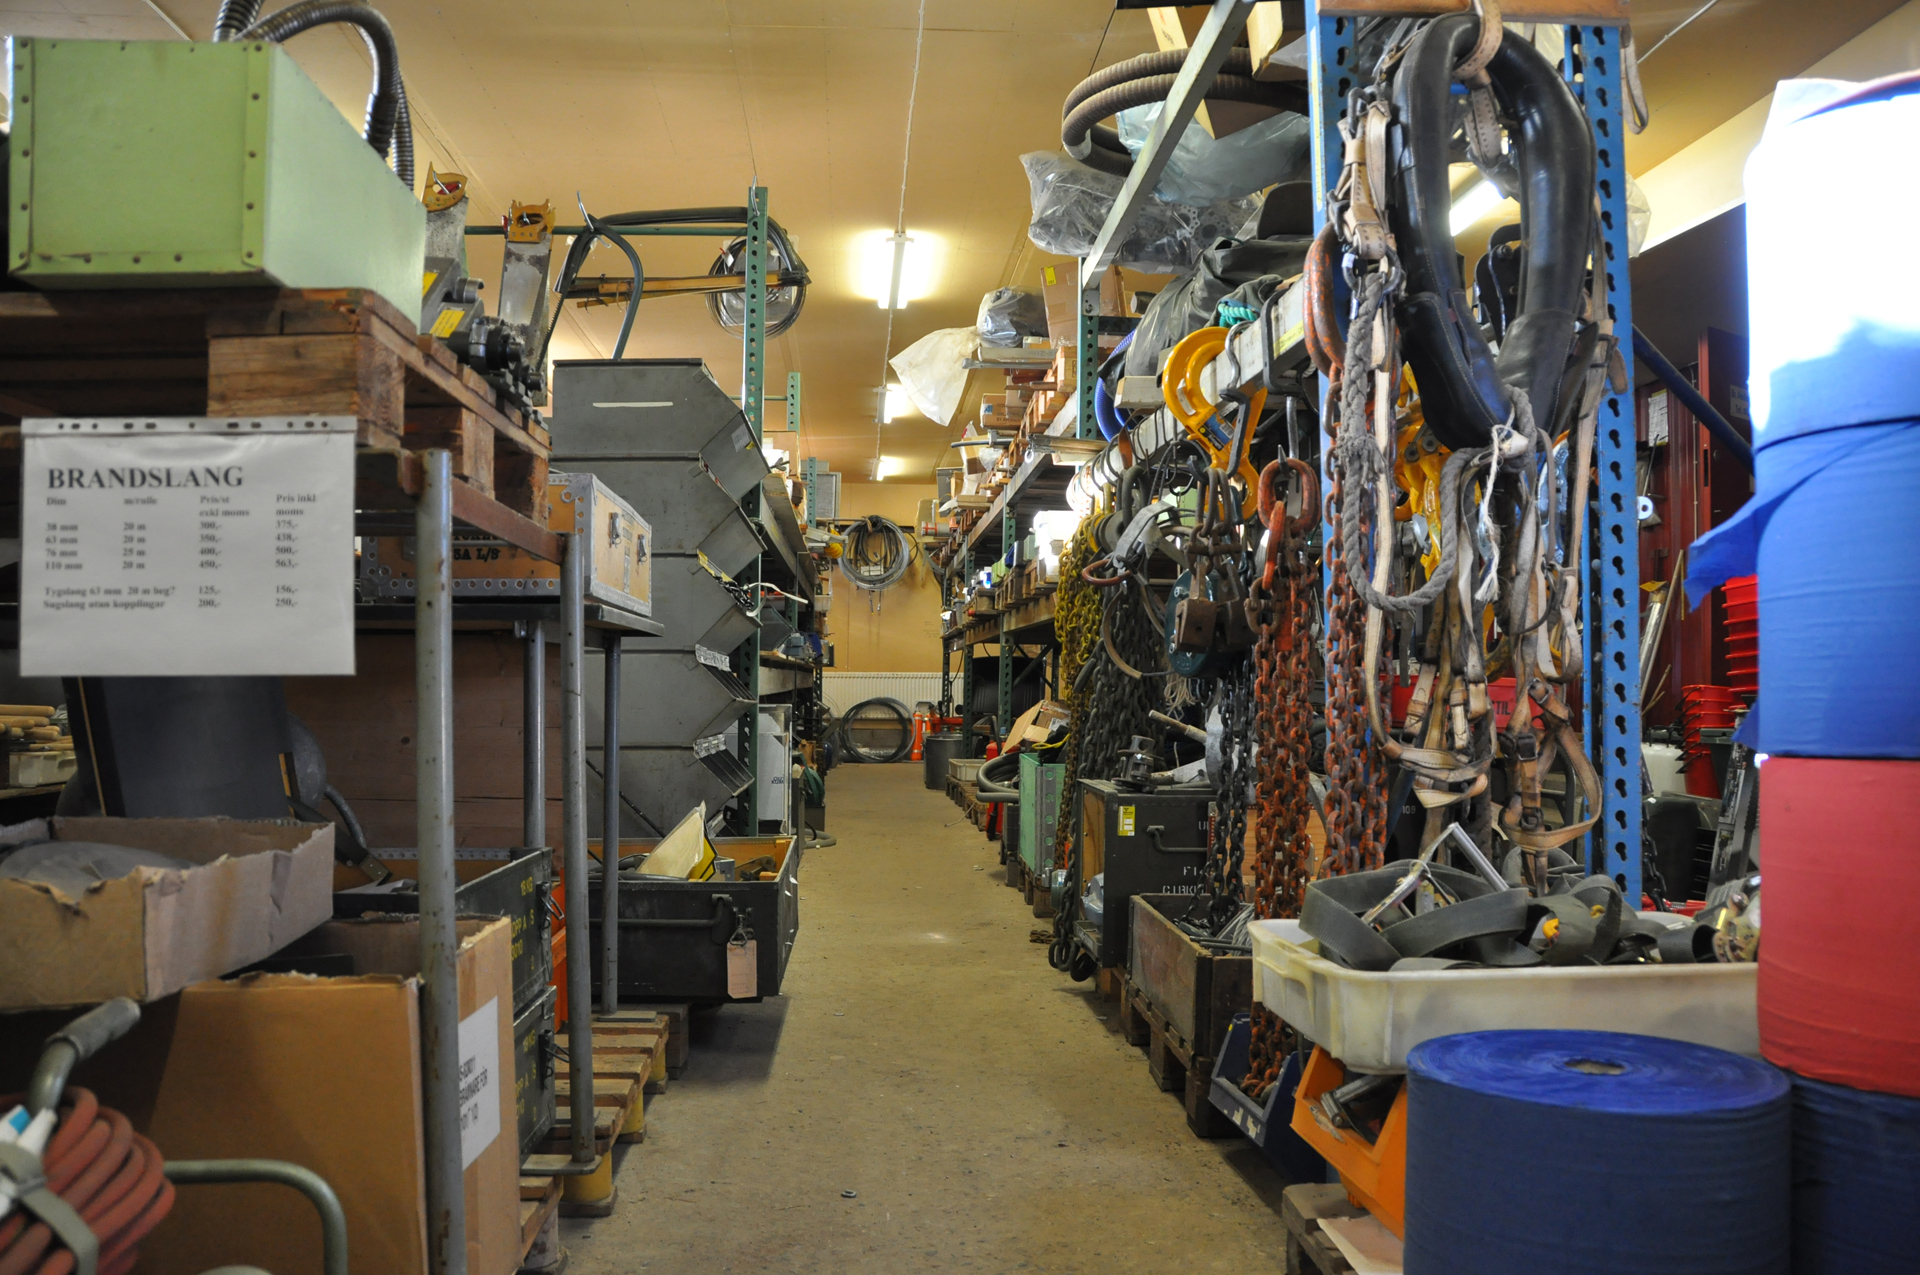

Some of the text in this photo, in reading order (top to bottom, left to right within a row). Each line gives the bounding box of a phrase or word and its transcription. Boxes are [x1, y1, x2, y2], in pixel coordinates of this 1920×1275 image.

[48, 465, 243, 489] BRANDSLANG
[46, 496, 67, 506] Dim
[275, 493, 316, 504] Pris inkl
[199, 507, 250, 517] exkl moms
[275, 507, 304, 516] moms
[45, 522, 79, 532] 38 mm
[123, 521, 146, 531] 20 m
[275, 519, 299, 530] 375,-
[45, 535, 78, 545] 63 mm
[122, 534, 146, 544] 20 m
[275, 532, 299, 543] 438,-
[45, 548, 78, 558] 76 mm
[122, 547, 146, 557] 25 m
[275, 545, 299, 556] 500,-
[44, 561, 83, 571] 110 mm
[121, 560, 145, 570] 20 m
[275, 558, 299, 569] 563,-
[89, 586, 101, 596] 63
[103, 587, 122, 596] mm
[127, 586, 139, 596] 20
[141, 587, 151, 596] m
[275, 584, 299, 595] 156,-
[88, 600, 110, 609] utan
[112, 599, 165, 611] kopplingar
[275, 597, 299, 608] 250,-
